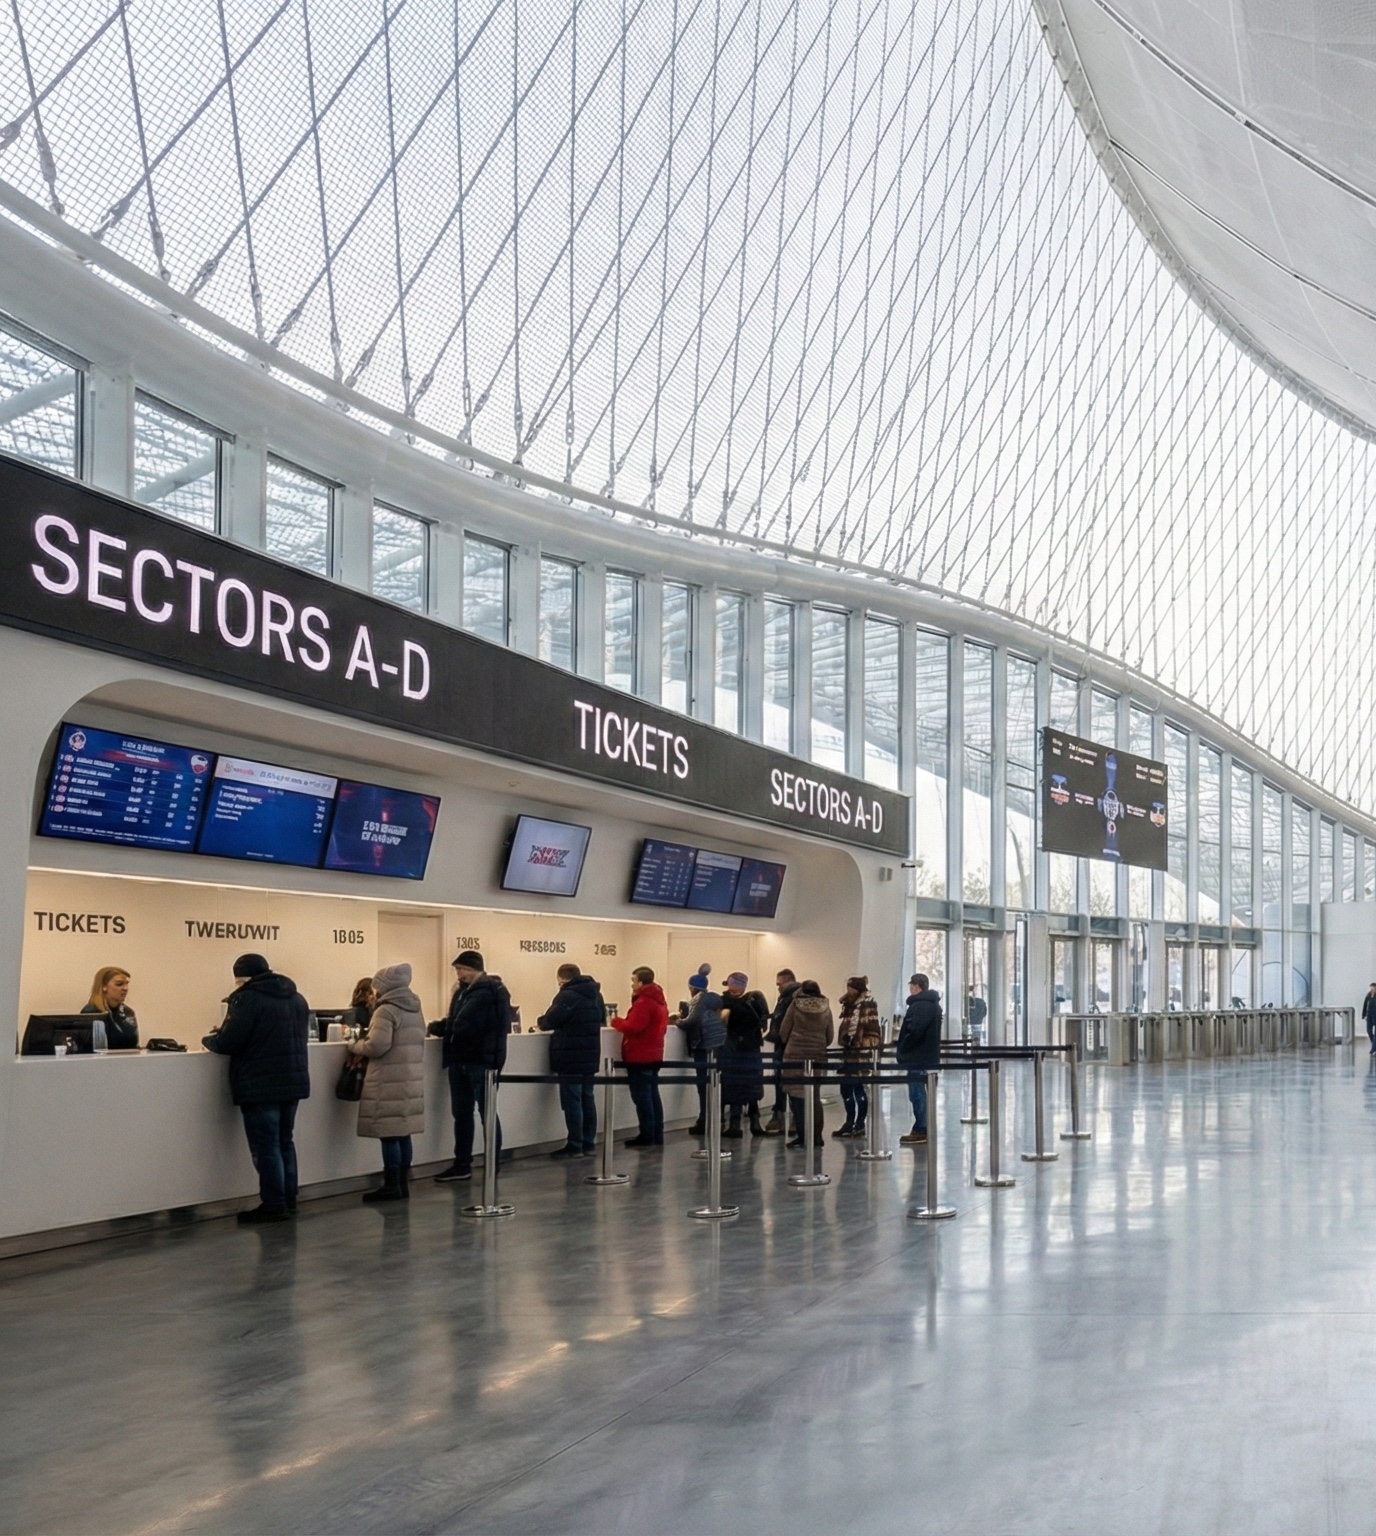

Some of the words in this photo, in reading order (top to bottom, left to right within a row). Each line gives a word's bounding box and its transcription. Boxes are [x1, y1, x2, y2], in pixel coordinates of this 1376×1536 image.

[31, 514, 331, 672] SECTORS
[344, 625, 430, 700] A-D
[573, 699, 689, 779] TICKETS
[770, 768, 852, 825] SECTORS
[854, 796, 883, 834] A-D
[33, 911, 126, 934] TICKETS
